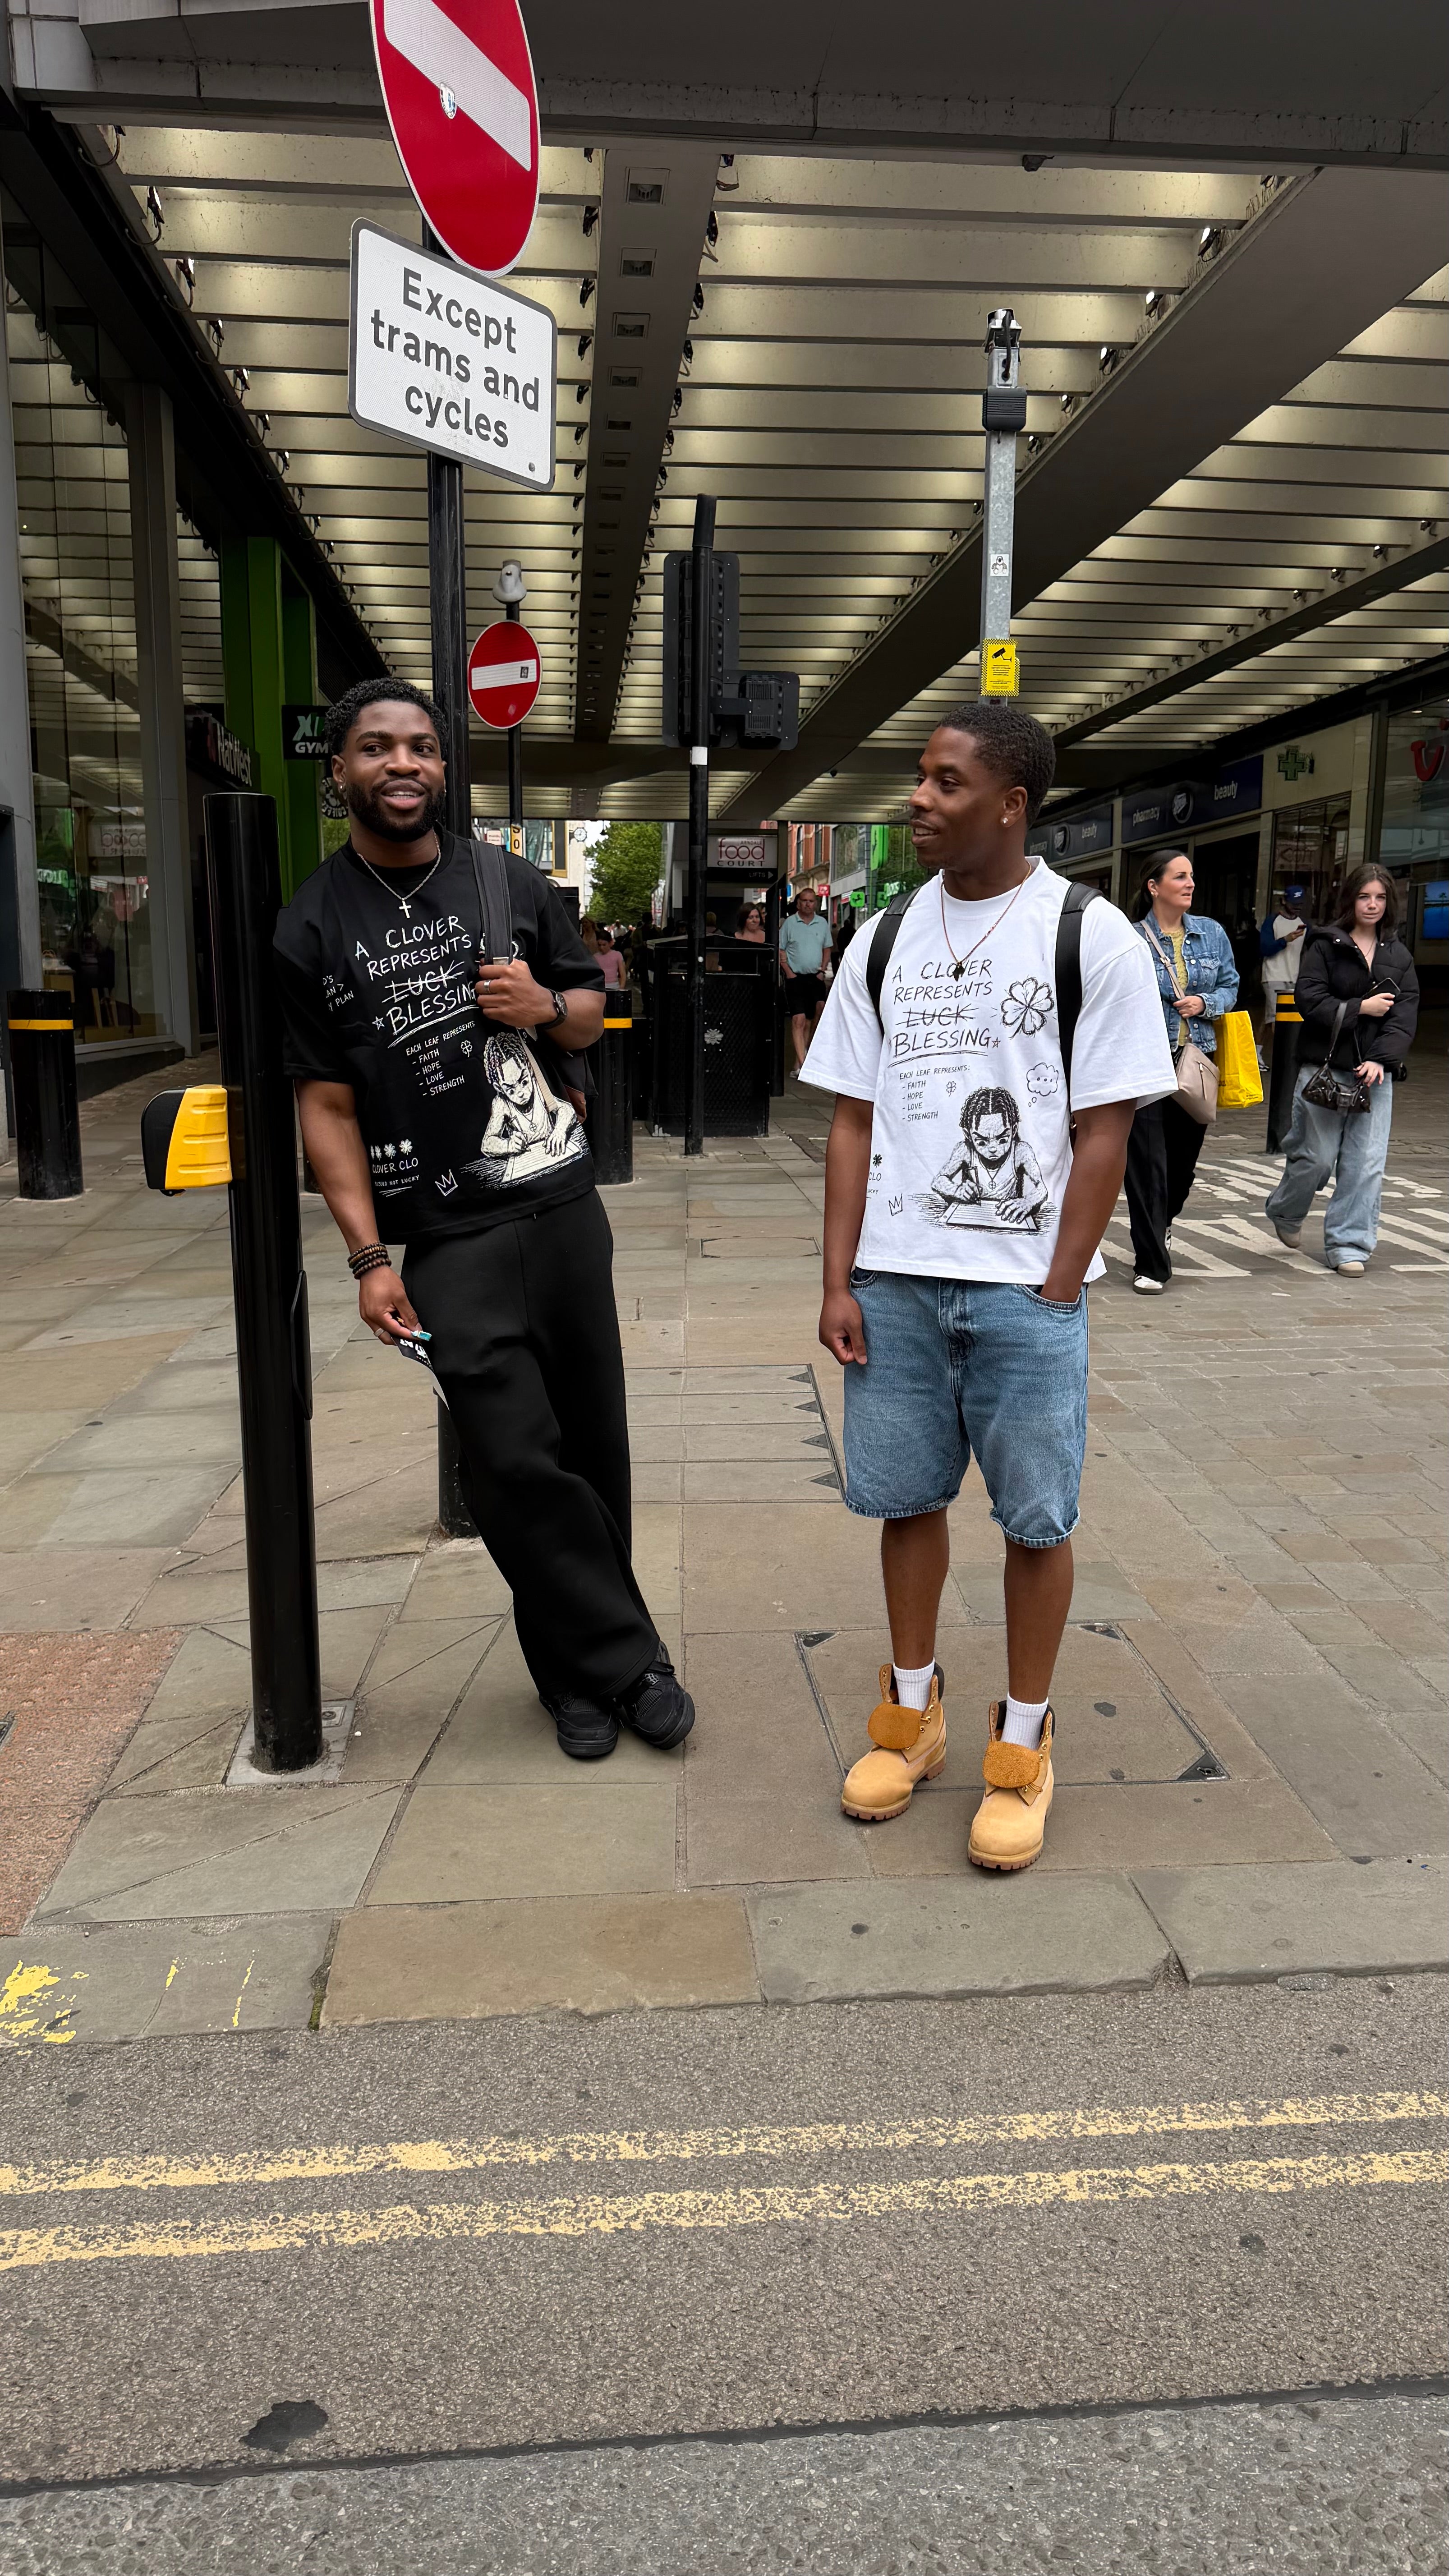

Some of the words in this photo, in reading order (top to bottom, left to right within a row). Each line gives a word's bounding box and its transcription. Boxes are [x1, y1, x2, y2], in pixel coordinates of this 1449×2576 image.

[403, 267, 516, 354] Except
[371, 309, 470, 383] trams
[484, 367, 539, 411] and
[406, 386, 508, 447] cycles
[216, 722, 252, 787] NatWest
[295, 742, 328, 754] GYM
[1214, 781, 1238, 800] beauty
[1132, 806, 1160, 827] pharmacy
[718, 838, 765, 860] food
[355, 941, 370, 960] A
[385, 915, 465, 948] CLOVER
[367, 934, 472, 981] REPRESENTS
[322, 975, 334, 985] D'S
[384, 960, 465, 1003] LUCK
[892, 965, 902, 984] A
[326, 986, 336, 998] AN
[335, 990, 354, 1007] PLAN
[894, 981, 993, 1005] REPRESENTS
[386, 981, 476, 1036] BLESSING
[897, 1003, 979, 1028] LUCK
[406, 1043, 421, 1056] EACH
[425, 1036, 439, 1048] LEAF
[893, 1028, 991, 1058] BLESSING
[419, 1049, 440, 1063] FAITH
[422, 1061, 442, 1075] HOPE
[900, 1072, 913, 1080] EACH
[934, 1065, 970, 1075] REPRESENTS:
[426, 1071, 444, 1085] LOVE
[430, 1075, 465, 1095] STRENGTH
[908, 1080, 926, 1090] FAITH
[907, 1091, 923, 1100] HOPE
[907, 1102, 923, 1111] LOVE
[907, 1111, 938, 1122] STRENGTH
[399, 1158, 418, 1170] CLO
[401, 1175, 419, 1184] LUCKY
[869, 1172, 881, 1181] CLO
